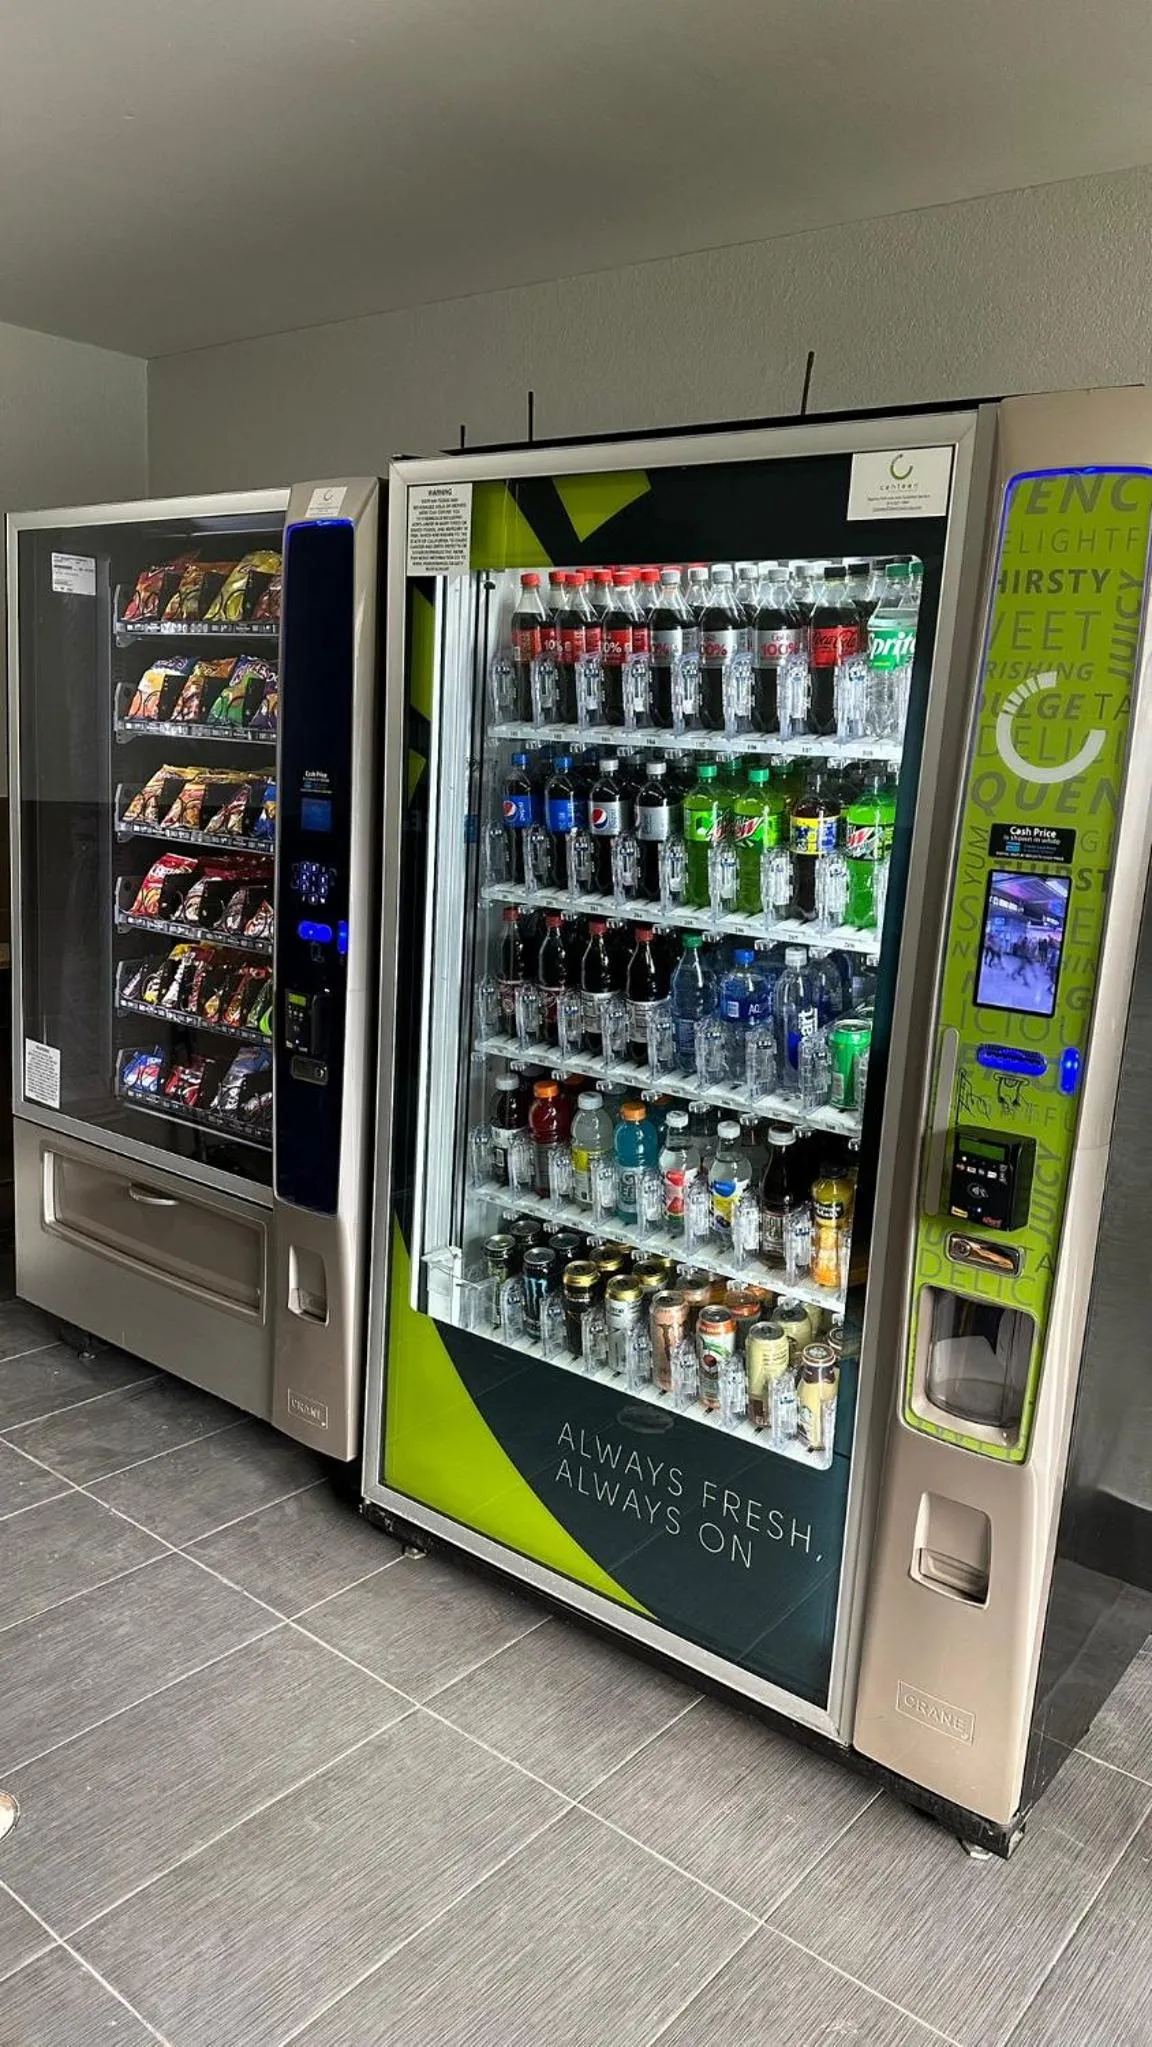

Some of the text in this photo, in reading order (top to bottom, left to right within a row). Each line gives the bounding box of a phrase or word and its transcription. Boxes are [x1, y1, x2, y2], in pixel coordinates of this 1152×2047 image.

[1010, 826, 1057, 839] Cash Price
[555, 1458, 752, 1568] ALWAYS ON
[557, 1422, 823, 1562] ALWAYS FRESH,
[904, 1693, 966, 1734] CRANE
